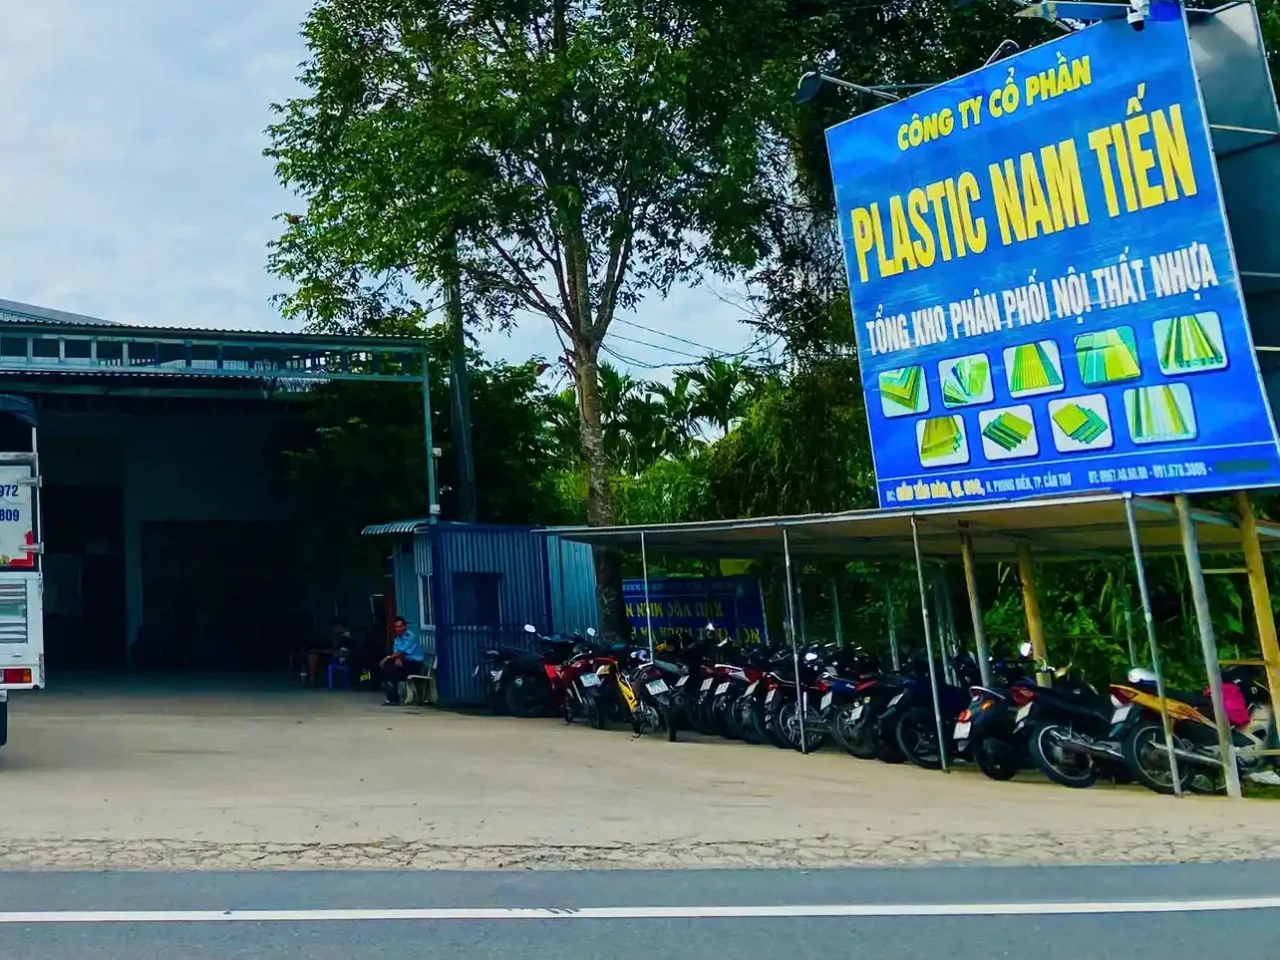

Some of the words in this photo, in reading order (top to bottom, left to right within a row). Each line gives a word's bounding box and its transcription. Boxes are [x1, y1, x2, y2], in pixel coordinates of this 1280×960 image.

[898, 113, 954, 151] CÔNG
[958, 95, 983, 129] TY
[988, 66, 1020, 118] CỔ
[1025, 51, 1092, 106] PHẦN
[850, 171, 987, 283] PLASTIC
[988, 138, 1090, 246] NAM
[1088, 83, 1197, 218] TIẾN
[866, 303, 910, 356] TỔNG
[913, 305, 948, 346] KHO
[950, 288, 1002, 340] PHÂN
[1004, 268, 1051, 329] PHỐI
[1054, 266, 1092, 324] NỘI
[1092, 246, 1147, 309] THẤT
[1150, 241, 1219, 301] NHỰA
